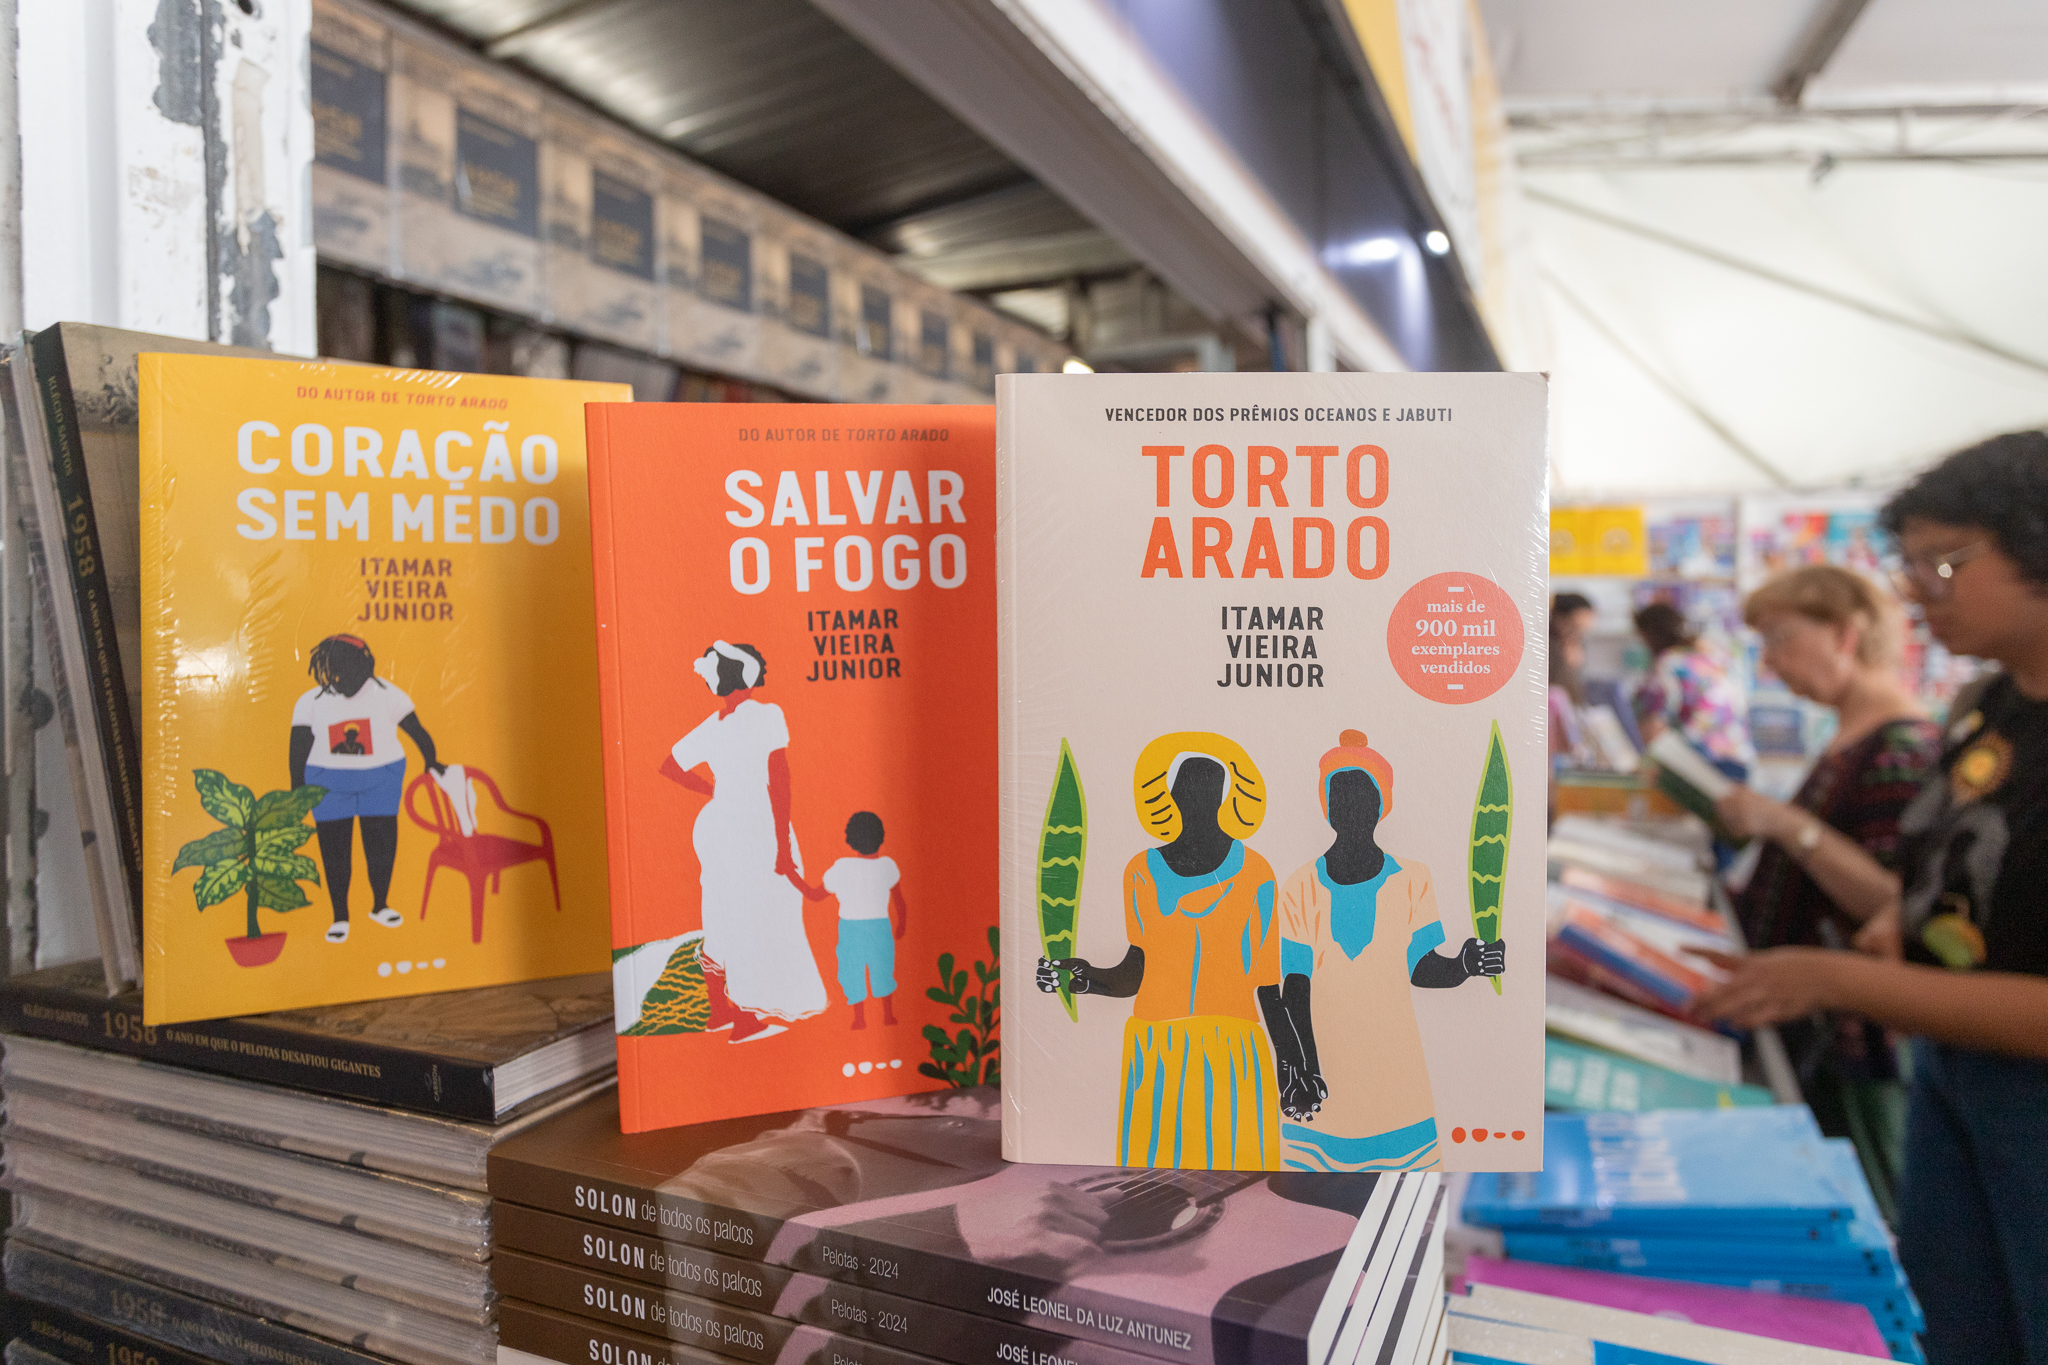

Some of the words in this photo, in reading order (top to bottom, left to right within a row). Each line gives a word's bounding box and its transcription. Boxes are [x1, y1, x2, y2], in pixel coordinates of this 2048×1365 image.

[297, 386, 318, 400] DO
[324, 388, 376, 403] AUTOR
[381, 392, 400, 405] DE
[407, 393, 455, 408] TORTO
[460, 396, 509, 411] ARADO
[1105, 407, 1188, 422] VENCEDOR
[1193, 407, 1225, 422] DOS
[1230, 404, 1299, 422] PRÊMIOS
[1304, 407, 1377, 422] OCEANOS
[1382, 408, 1391, 422] E
[1396, 408, 1452, 422] JABUTI
[739, 428, 760, 442] DO
[765, 428, 816, 442] AUTOR
[822, 428, 840, 442] DE
[847, 428, 896, 442] TORTO
[900, 428, 950, 442] ARADO
[237, 420, 559, 490] CORAÇÃO
[1141, 444, 1390, 509] TORTO
[724, 469, 967, 528] SALVAR
[236, 487, 369, 541] SEM
[392, 492, 560, 546] MEDO
[67, 494, 95, 577] 1958
[1140, 515, 1390, 581] ARADO
[360, 557, 453, 578] ITAMAR
[729, 537, 771, 596] O
[794, 533, 968, 592] FOGO
[365, 579, 448, 600] VIEIRA
[357, 602, 454, 622] JUNIOR
[1221, 605, 1325, 631] ITAMAR
[1426, 599, 1463, 613] mais
[1466, 599, 1486, 613] de
[807, 608, 899, 632] ITAMAR
[1415, 619, 1458, 637] 900
[1462, 619, 1497, 637] mil
[813, 633, 895, 656] VIEIRA
[1226, 634, 1319, 660] VIEIRA
[1411, 642, 1500, 659] exemplares
[806, 657, 902, 682] JUNIOR
[1216, 663, 1325, 688] JUNIOR
[1420, 660, 1491, 674] vendidos
[103, 1011, 158, 1046] 1958
[166, 1028, 174, 1041] O
[175, 1031, 194, 1045] ANO
[195, 1032, 209, 1048] EM
[210, 1036, 230, 1052] QUE
[230, 1039, 238, 1052] O
[239, 1041, 280, 1060] PELOTAS
[281, 1049, 329, 1069] DESAFIOU
[330, 1058, 381, 1078] GIGANTES
[575, 1185, 636, 1220] SOLON
[641, 1200, 657, 1222] de
[660, 1204, 693, 1231] todos
[696, 1216, 711, 1235] os
[714, 1219, 754, 1246] palcos
[583, 1234, 645, 1269] SOLON
[650, 1250, 665, 1272] de
[668, 1254, 701, 1281] todos
[704, 1267, 719, 1286] os
[722, 1271, 762, 1298] palcos
[822, 1245, 859, 1270] Pelotas
[869, 1256, 899, 1280] 2024
[584, 1283, 646, 1320] SOLON
[651, 1301, 666, 1323] de
[669, 1305, 703, 1334] todos
[705, 1319, 721, 1339] os
[724, 1324, 764, 1350] palcos
[831, 1298, 868, 1324] Pelotas
[878, 1311, 908, 1334] 2024
[987, 1287, 1020, 1309] JOSÉ
[1023, 1295, 1073, 1322] LEONEL
[1076, 1307, 1095, 1327] DA
[1098, 1313, 1124, 1335] LUZ
[1126, 1320, 1192, 1351] ANTUNEZ
[996, 1342, 1029, 1365] JOSÉ
